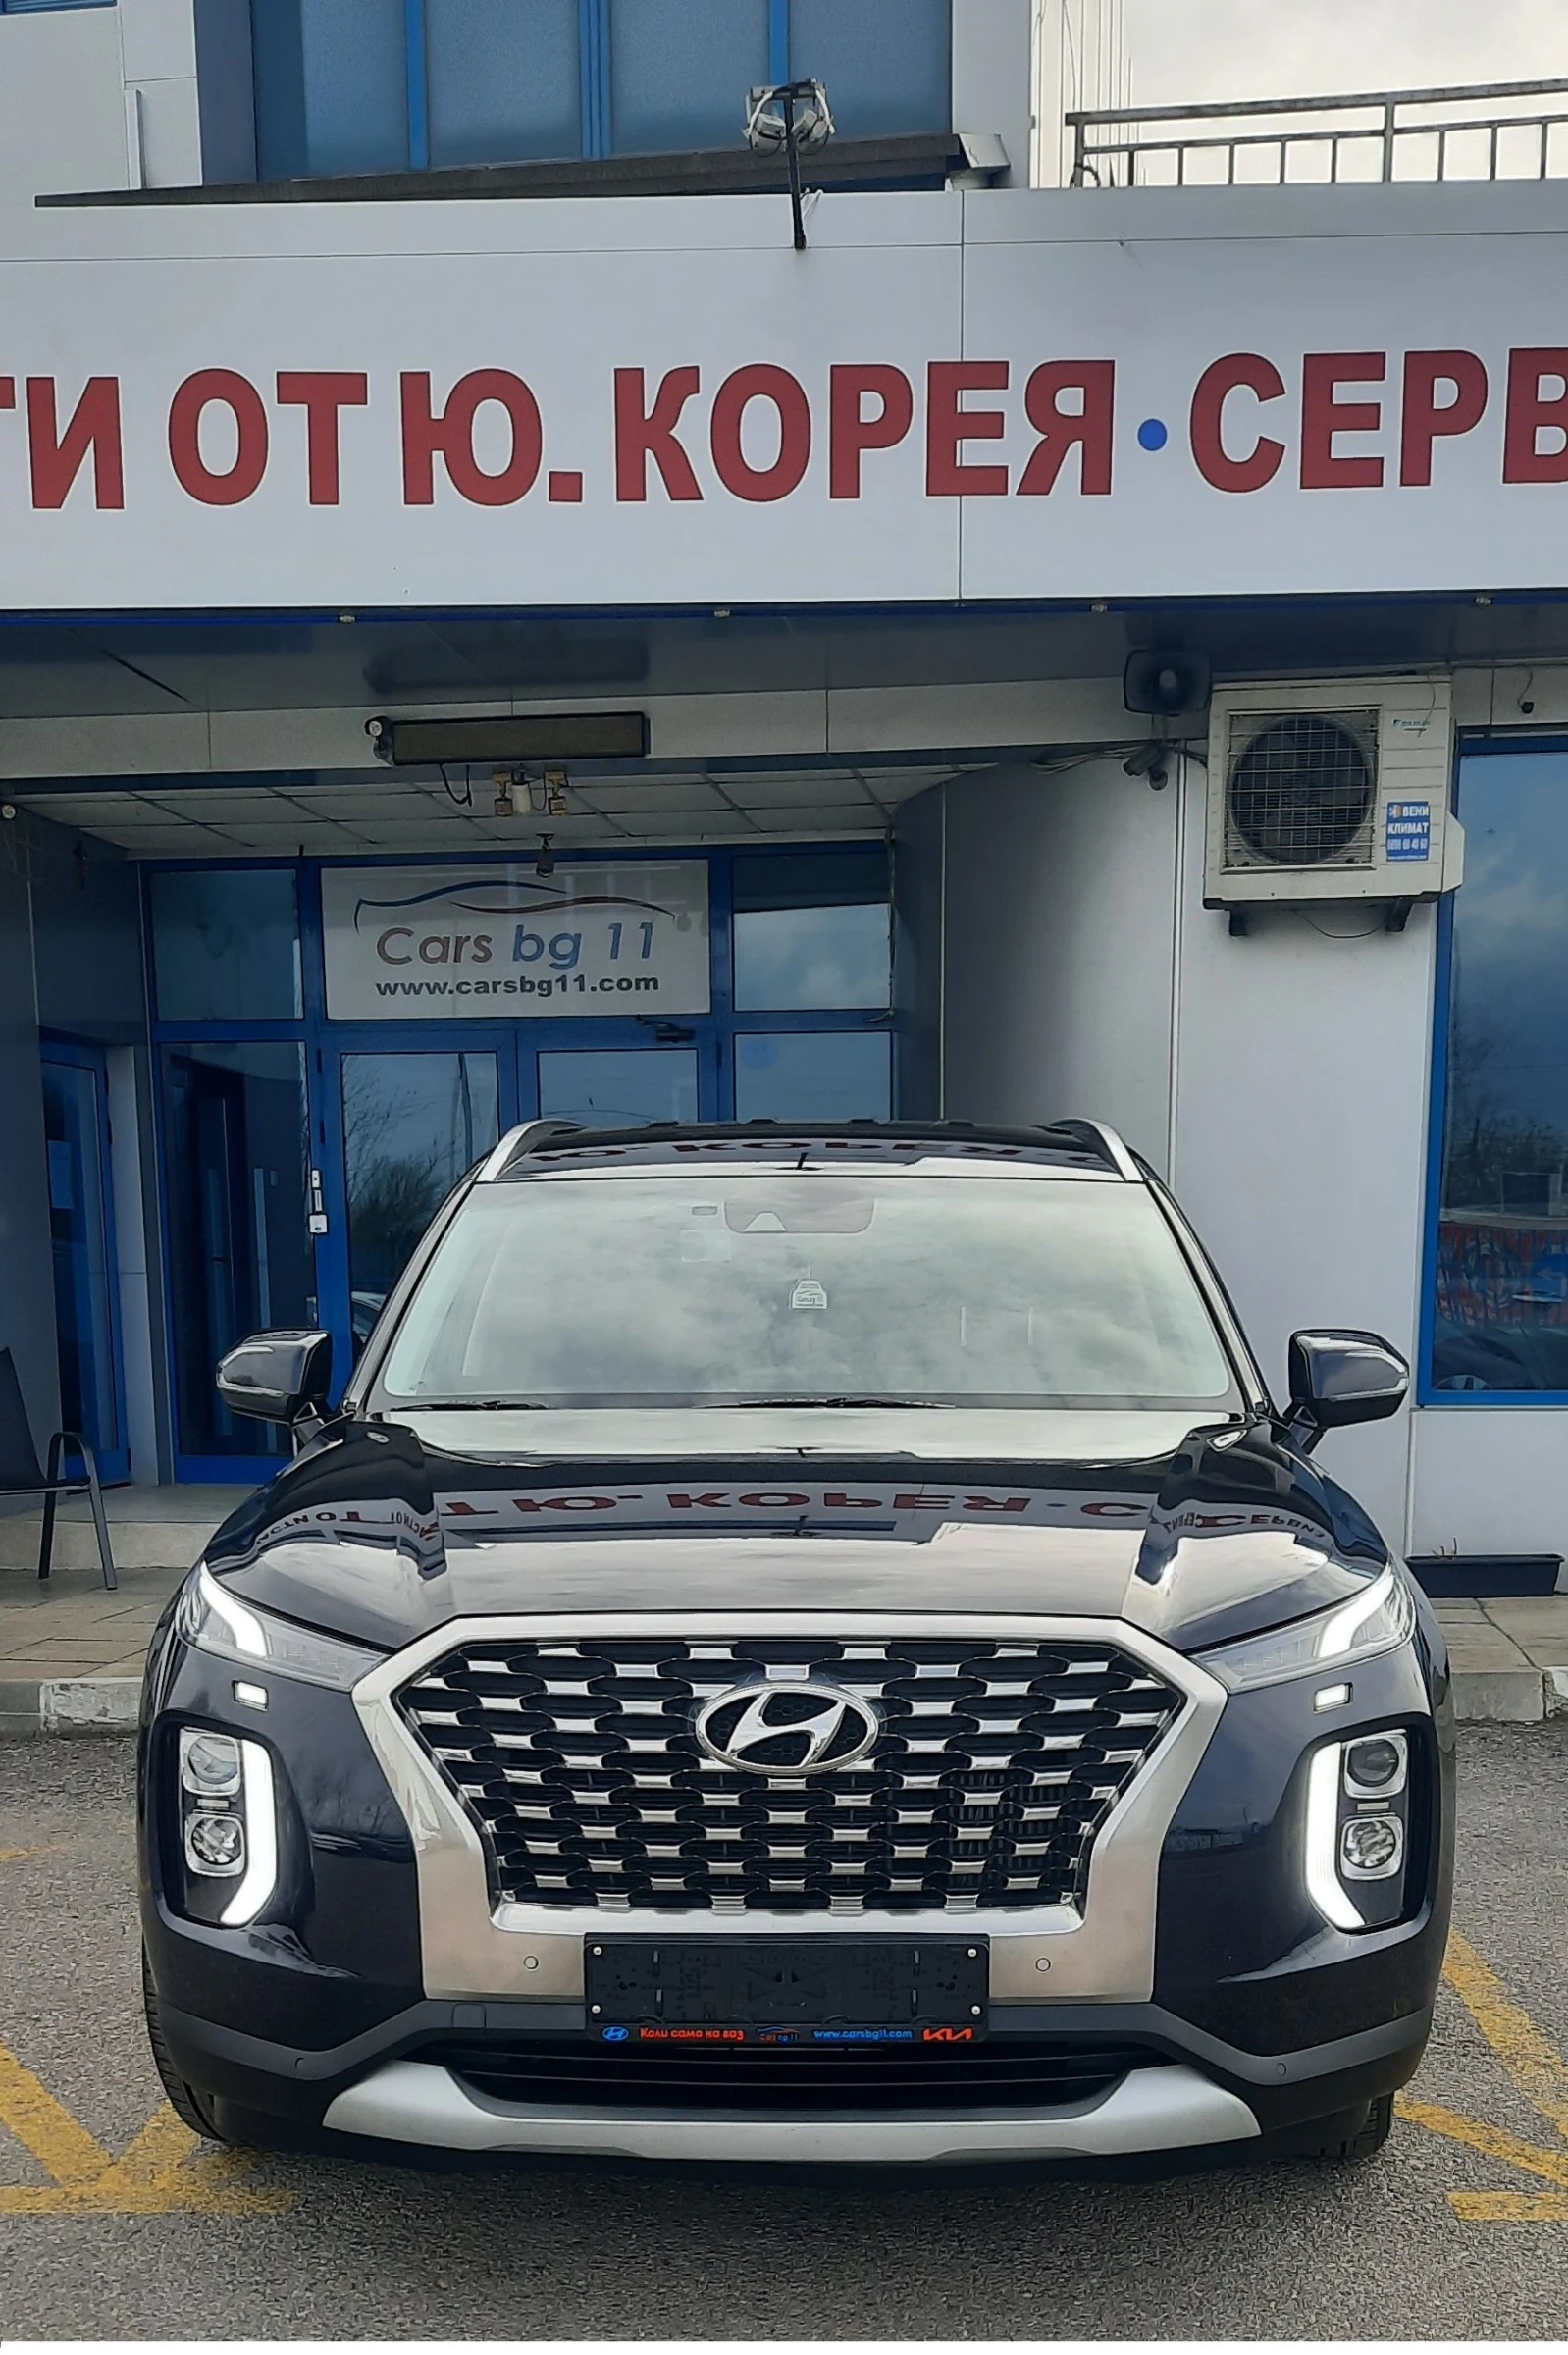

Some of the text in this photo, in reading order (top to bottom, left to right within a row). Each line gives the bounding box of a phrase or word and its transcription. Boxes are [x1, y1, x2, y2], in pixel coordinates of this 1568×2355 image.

[168, 367, 369, 506] ОТ
[399, 368, 583, 506] Ю.
[613, 359, 1116, 503] КОРЕЯ
[1189, 347, 1568, 494] СЕРВ
[1402, 805, 1429, 817] ВЕНИ
[1387, 822, 1429, 835] КЛИМАТ
[376, 921, 654, 970] Cars bg 11
[375, 974, 659, 998] www.carsbg11.com
[640, 2027, 668, 2038] Коли
[670, 2028, 703, 2038] само
